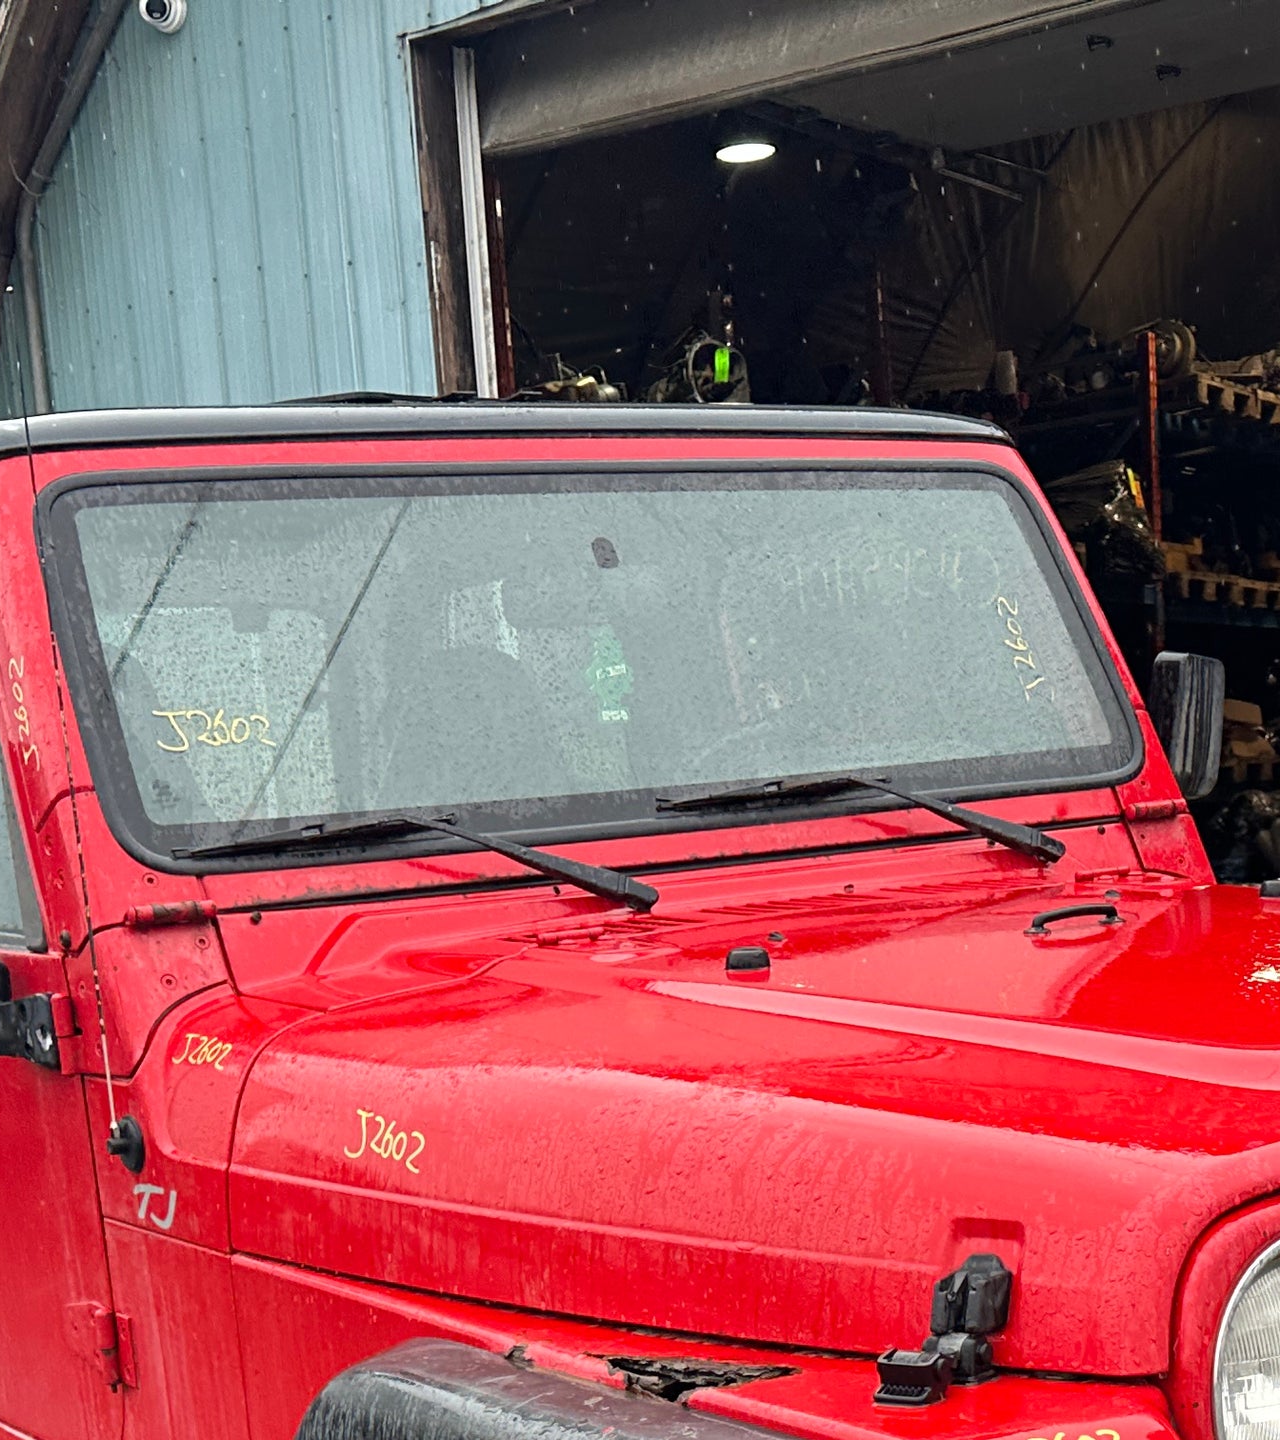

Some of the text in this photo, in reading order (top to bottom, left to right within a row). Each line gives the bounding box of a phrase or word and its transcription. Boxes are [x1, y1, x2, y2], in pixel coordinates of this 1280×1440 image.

[8, 655, 42, 773] J2602
[151, 709, 277, 754] J2602
[171, 1033, 233, 1072] J2602
[343, 1108, 426, 1174] J2602
[133, 1182, 177, 1230] TJ
